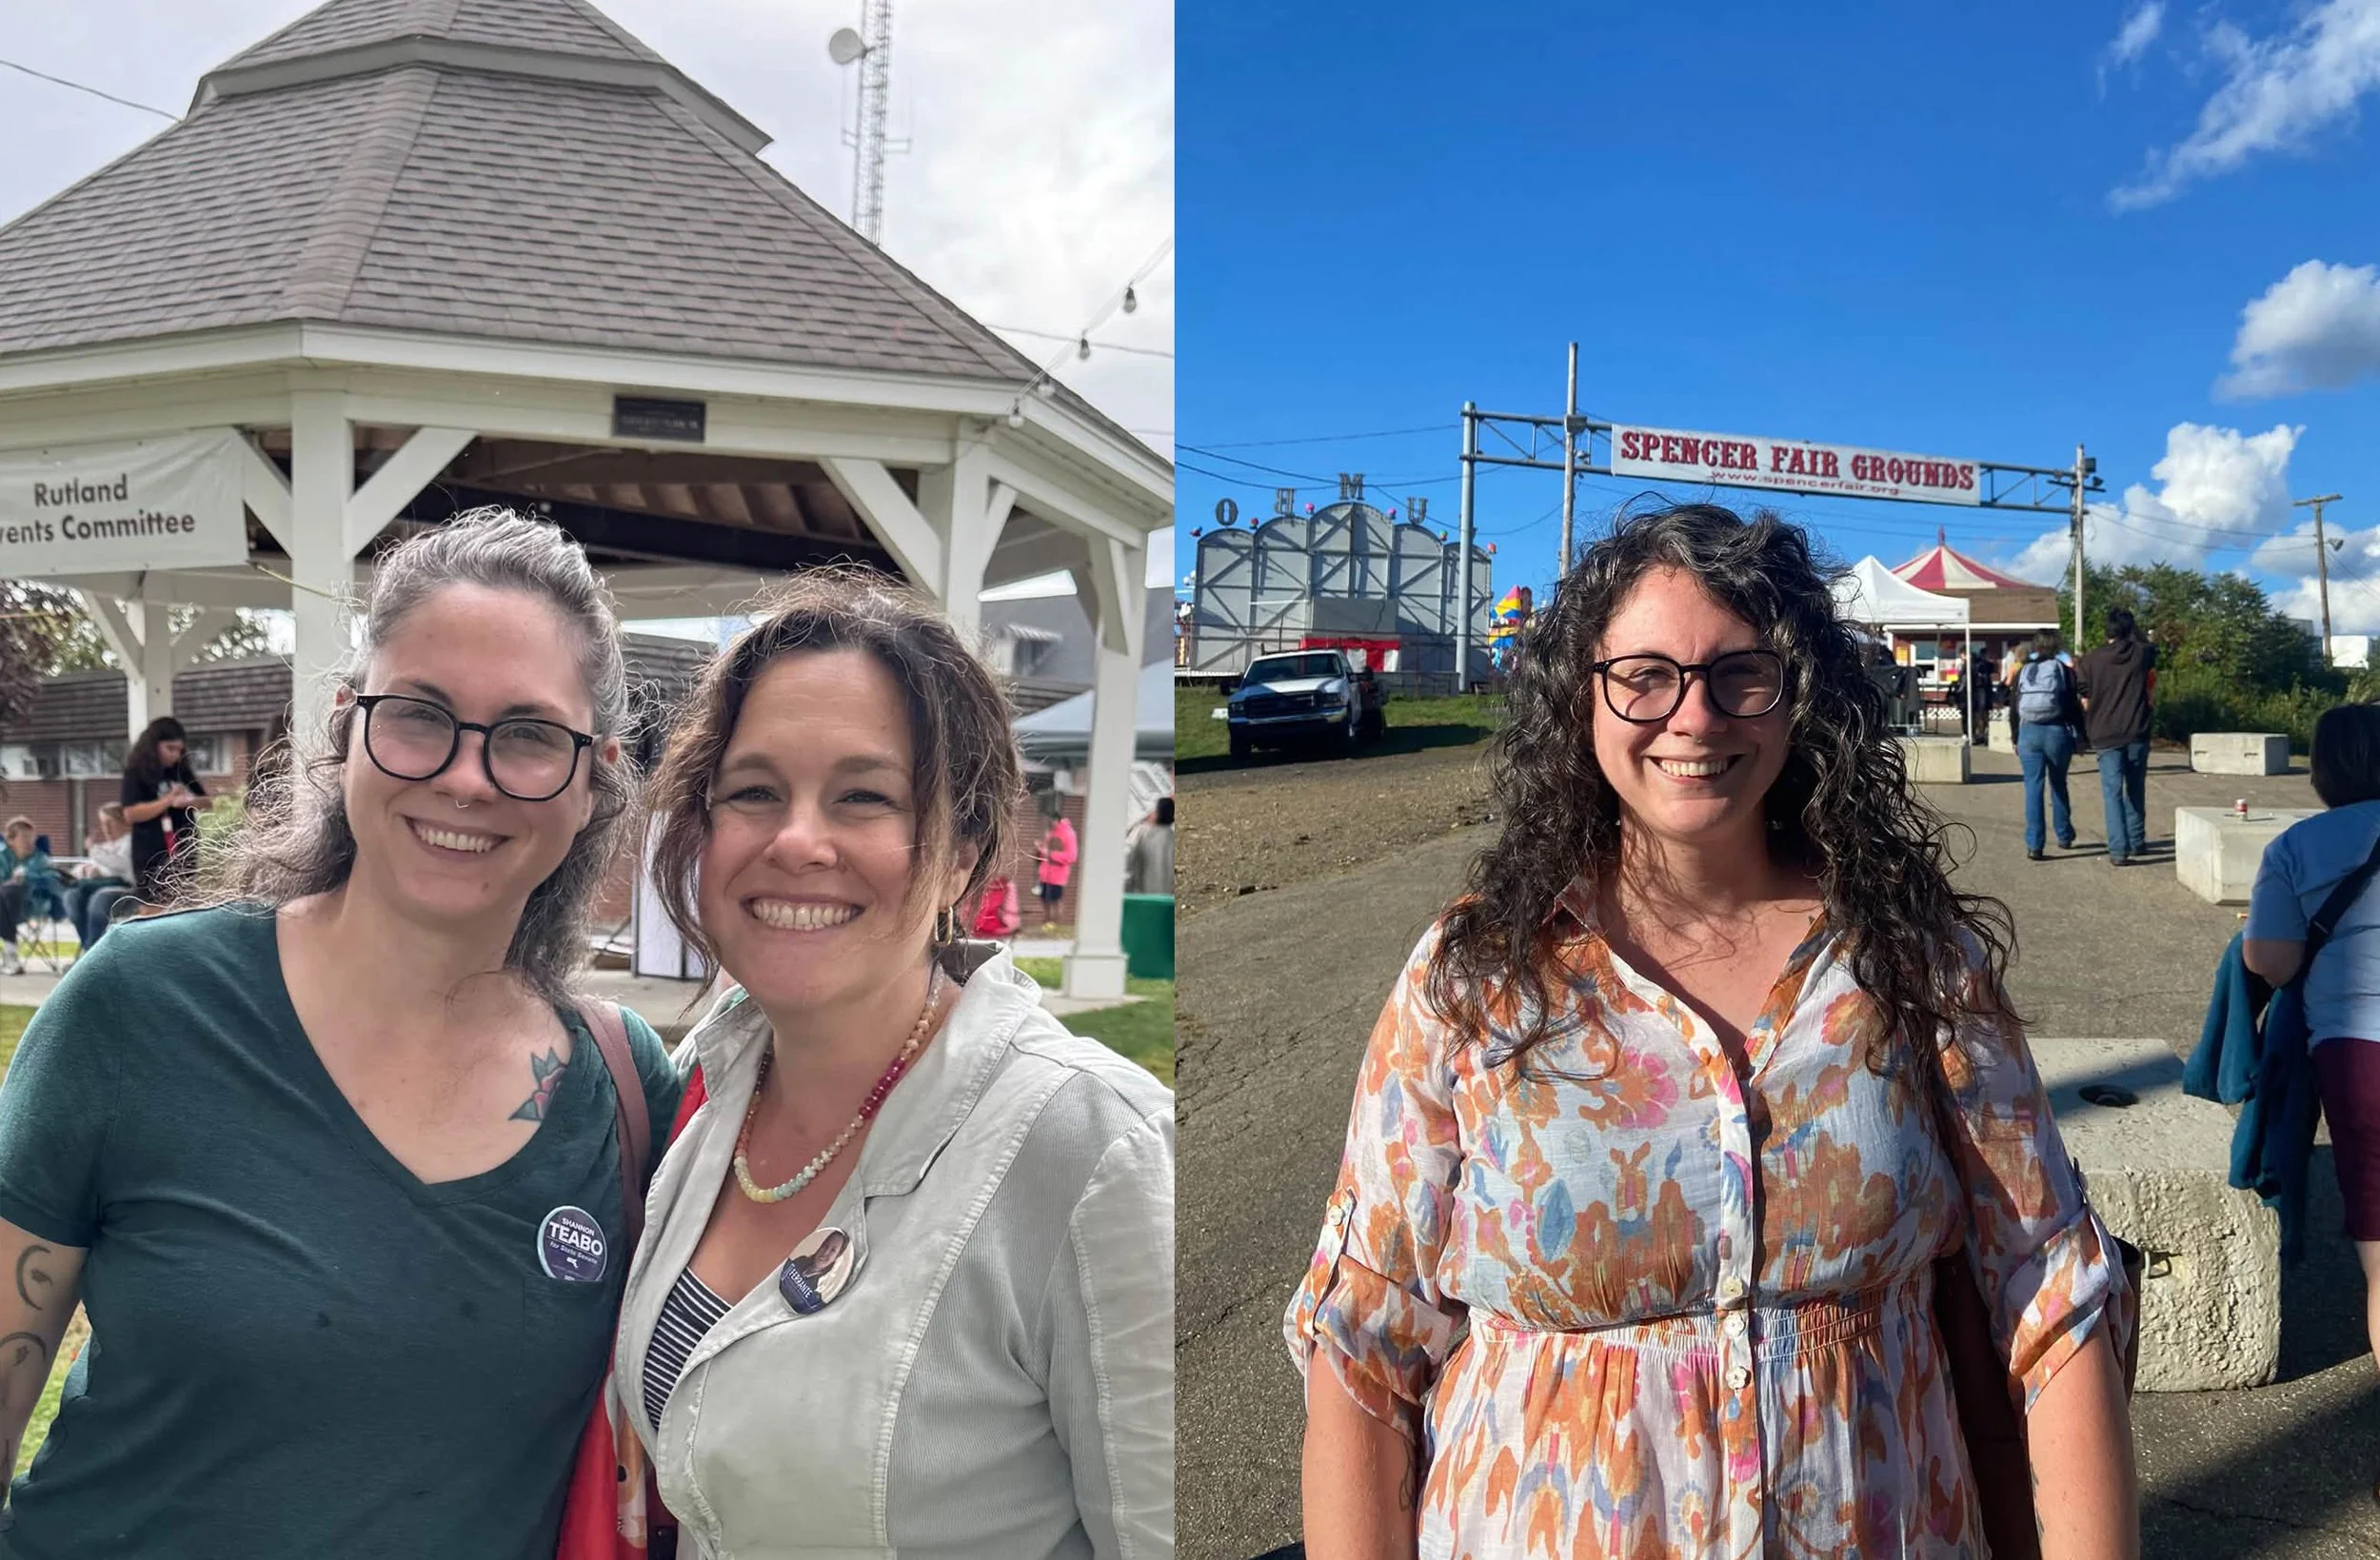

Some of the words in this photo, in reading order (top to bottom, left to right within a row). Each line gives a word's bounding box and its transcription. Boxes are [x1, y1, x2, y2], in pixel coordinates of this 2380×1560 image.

[1620, 430, 1759, 471] SPENCER
[1771, 445, 1839, 478] FAIR
[1850, 454, 1974, 490] GROUNDS
[34, 473, 129, 507] Rutland
[1712, 470, 1900, 496] www.spencerfair.org
[62, 509, 196, 541] Committee
[548, 1221, 604, 1256] TEABO
[562, 1217, 595, 1236] SHANNON
